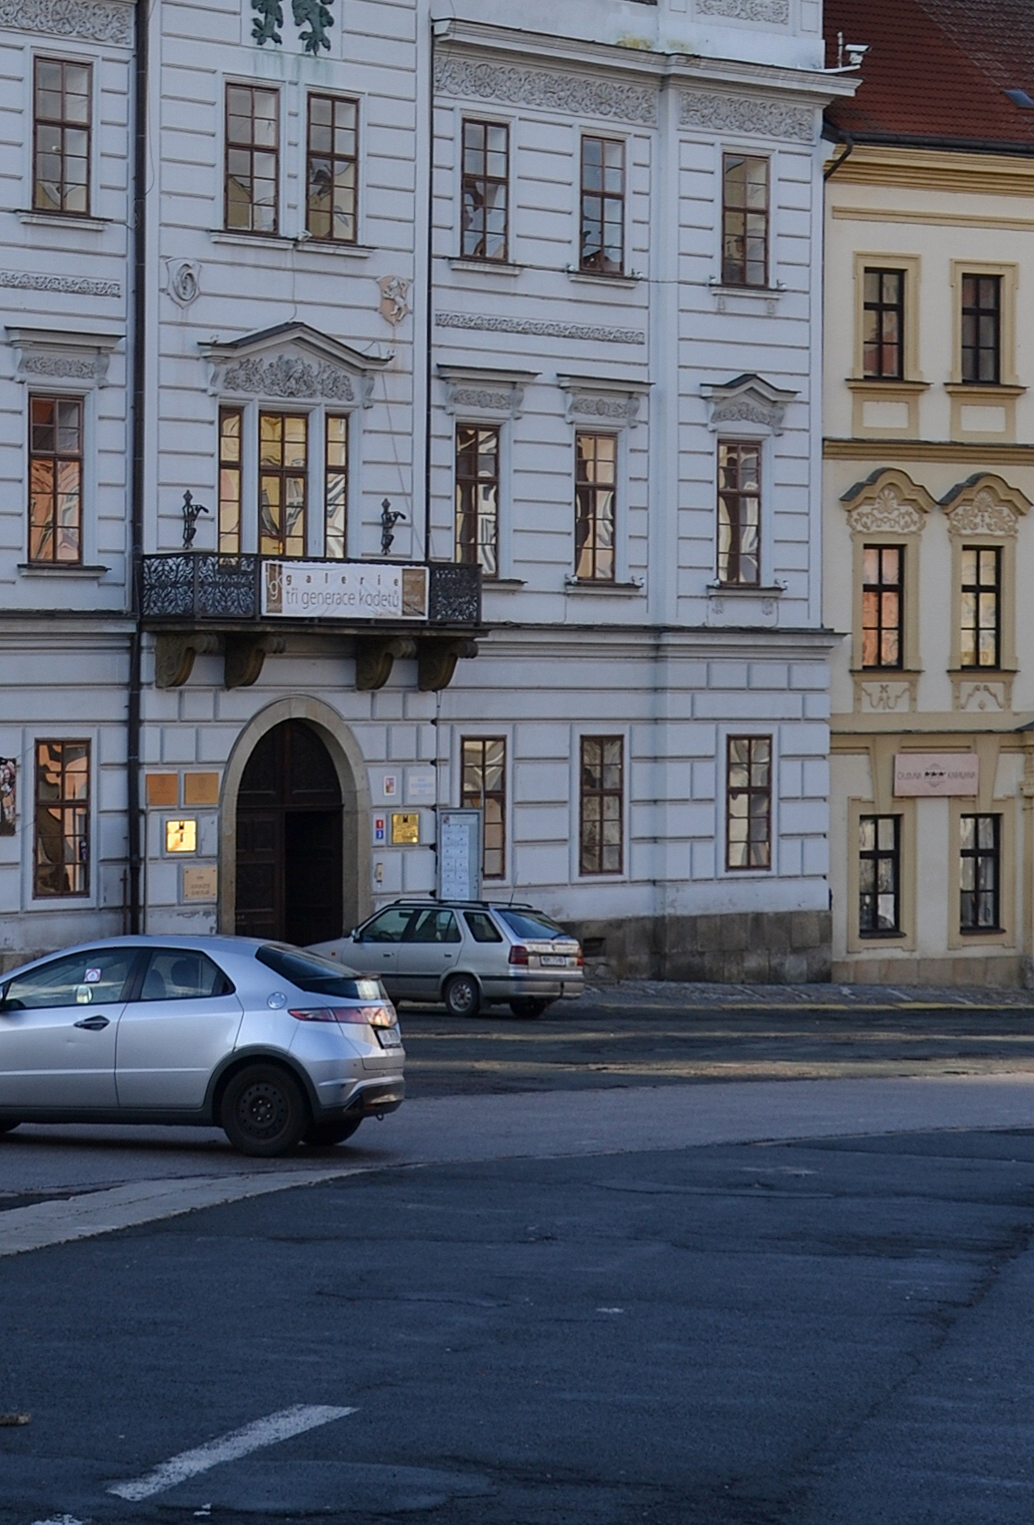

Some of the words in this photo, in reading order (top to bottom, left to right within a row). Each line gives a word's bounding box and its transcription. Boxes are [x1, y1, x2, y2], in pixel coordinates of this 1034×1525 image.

[286, 573, 399, 586] galerie
[301, 589, 356, 609] generace
[358, 589, 399, 608] kodetů
